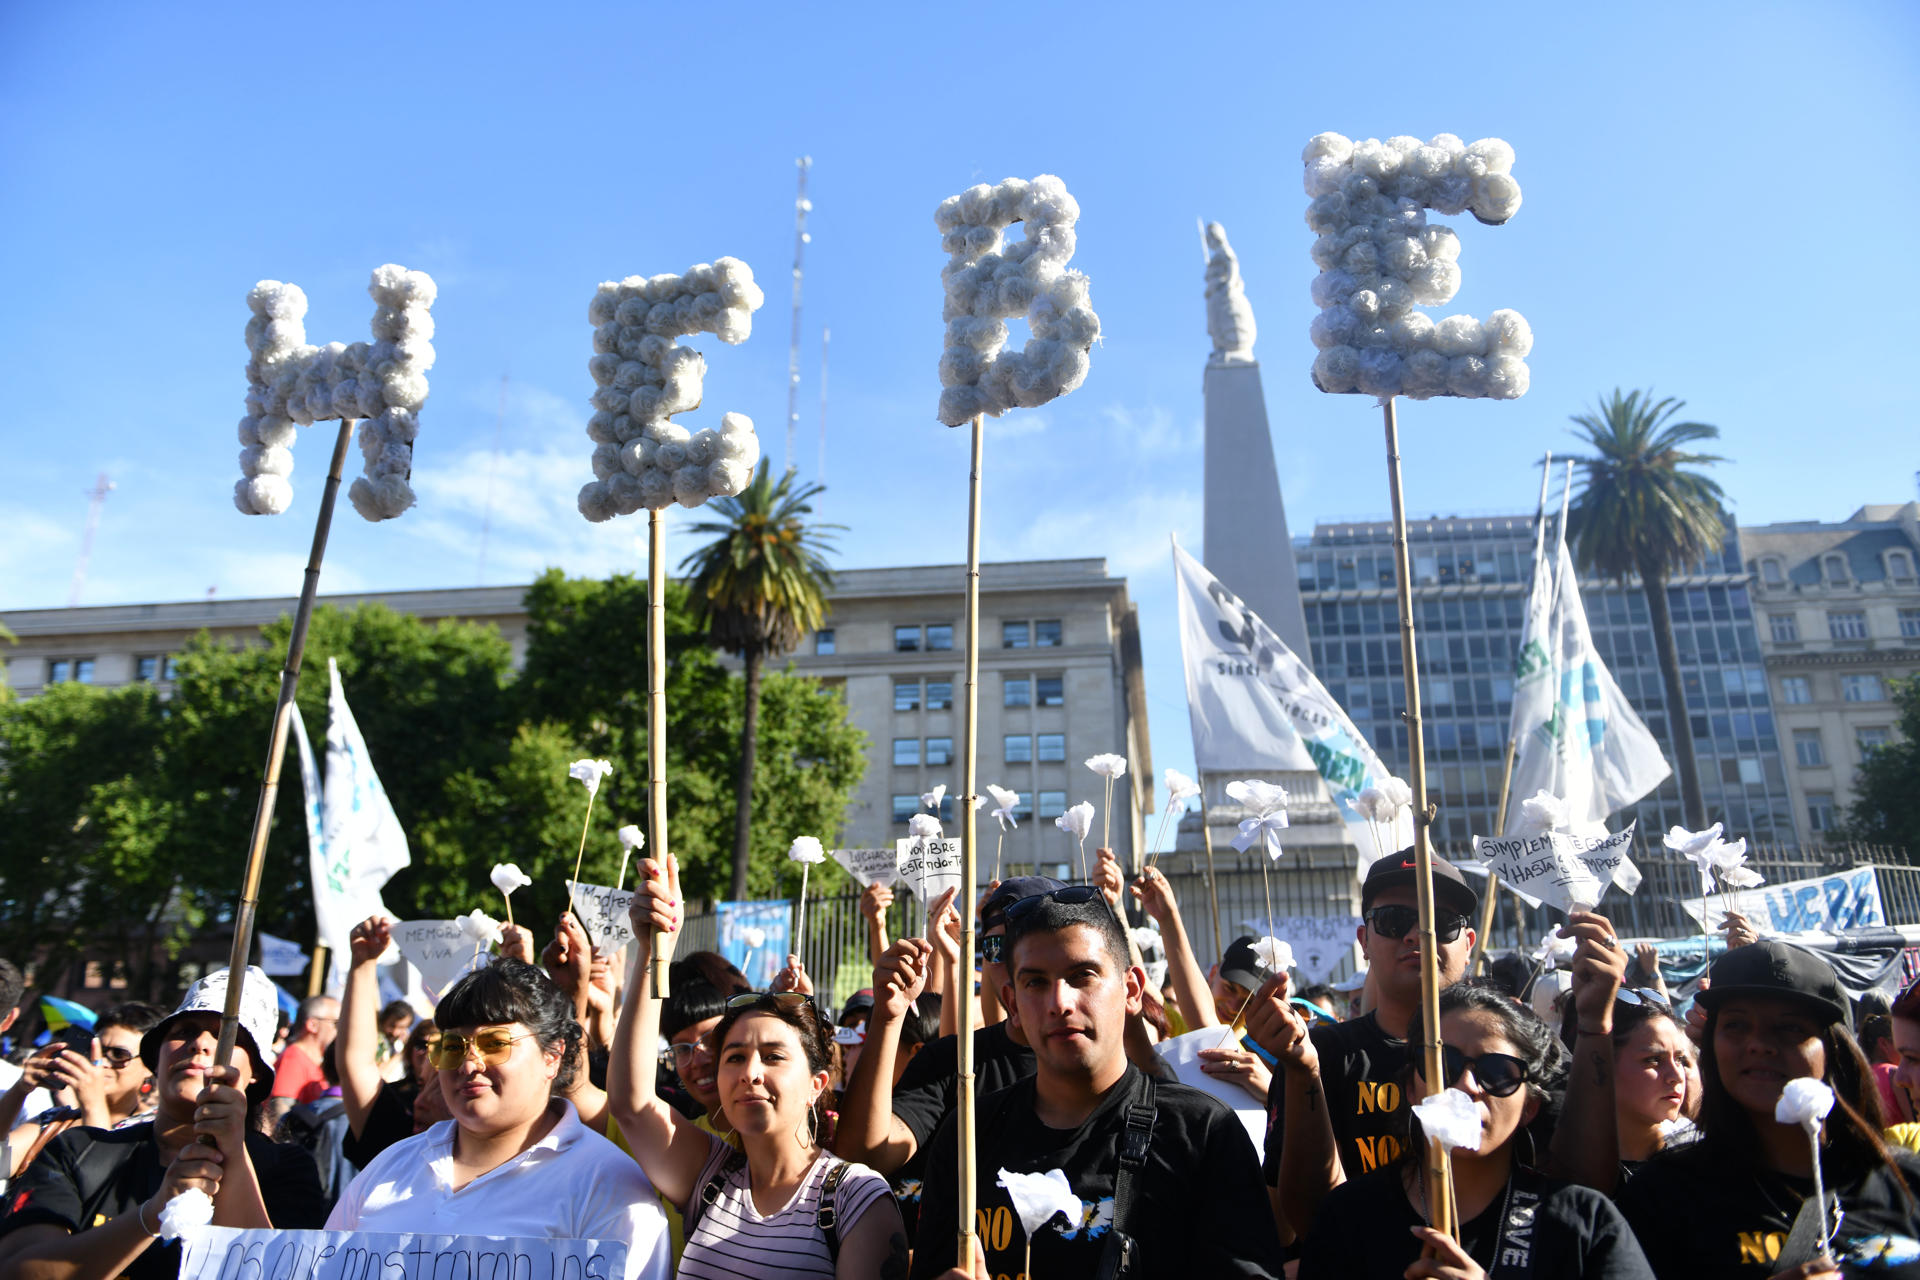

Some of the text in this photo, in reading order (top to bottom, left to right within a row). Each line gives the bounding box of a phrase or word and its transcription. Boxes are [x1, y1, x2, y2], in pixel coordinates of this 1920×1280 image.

[1498, 866, 1508, 881] Y
[1512, 856, 1555, 884] HASTA
[1357, 1081, 1400, 1114] NO
[976, 1206, 1013, 1251] NO
[1502, 1190, 1539, 1267] LOVE
